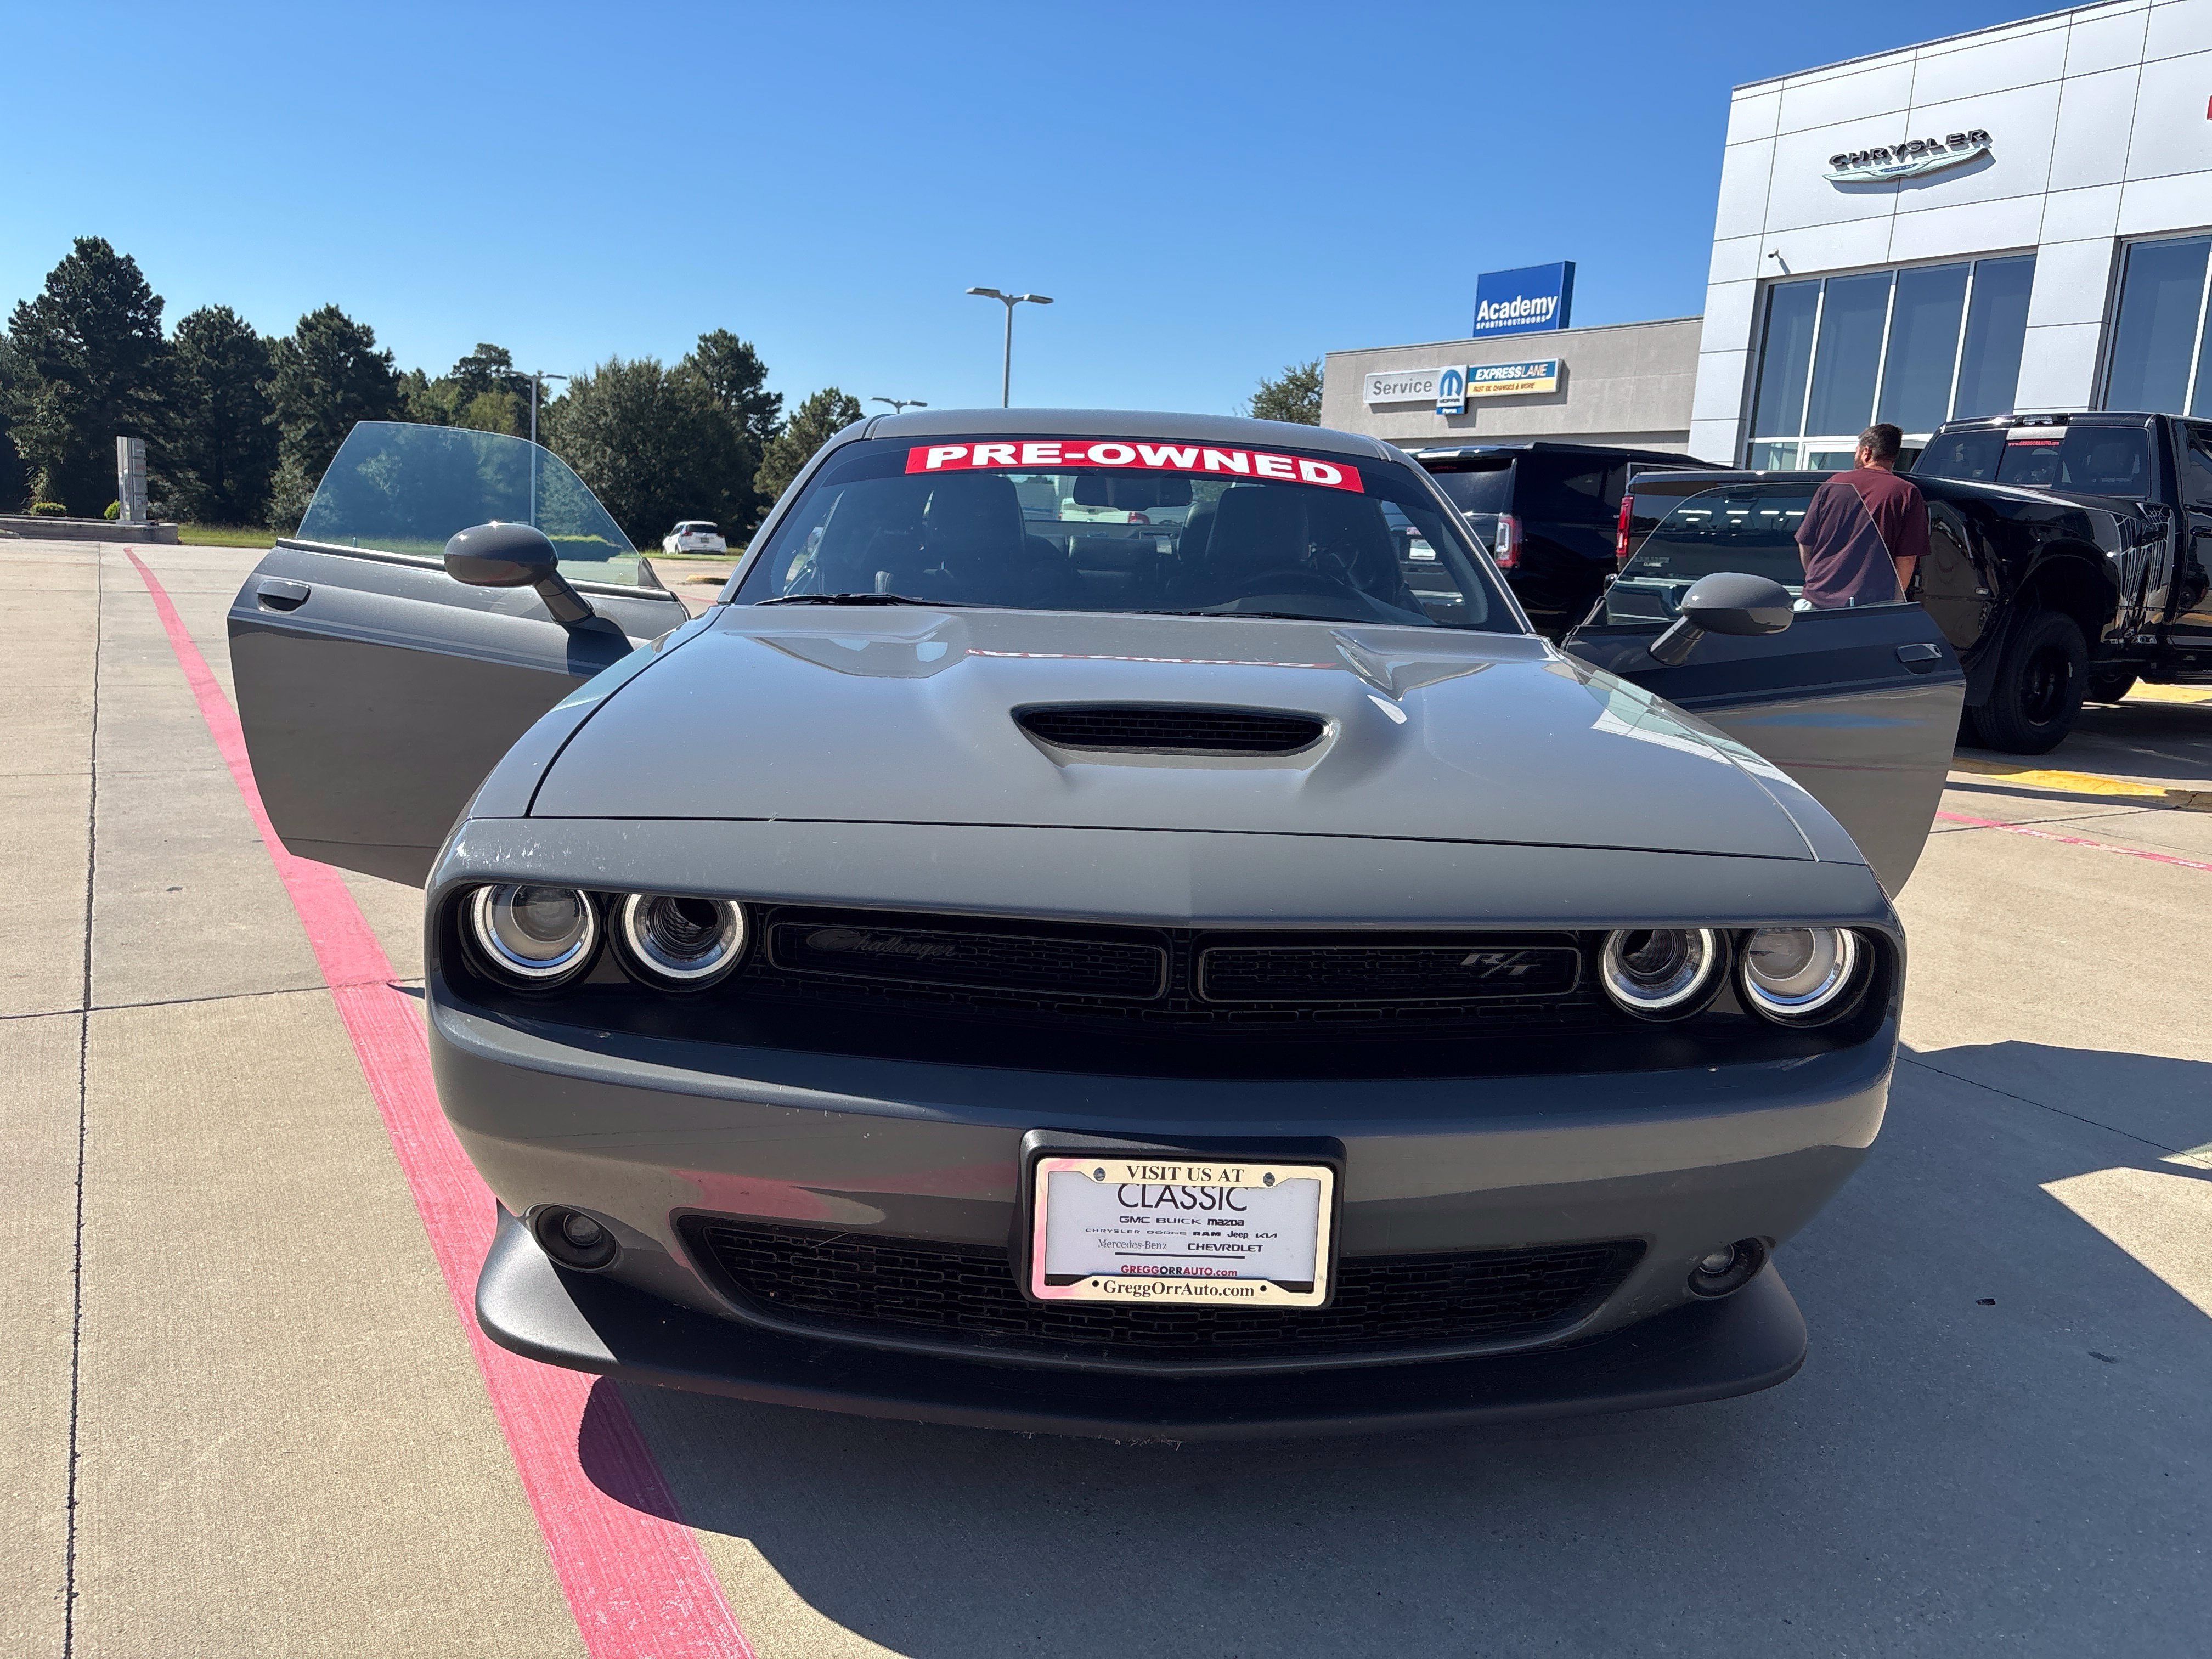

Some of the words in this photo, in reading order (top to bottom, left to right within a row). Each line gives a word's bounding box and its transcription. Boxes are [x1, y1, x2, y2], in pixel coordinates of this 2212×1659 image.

[1829, 129, 1993, 166] CHRYSLER
[1476, 295, 1558, 319] Academy
[1373, 377, 1433, 396] Service
[925, 443, 1343, 485] PRE-OWNED
[1460, 951, 1542, 978] R/T
[1126, 1165, 1181, 1180] VISIT
[1187, 1167, 1212, 1182] US
[1217, 1168, 1245, 1182] AT
[1118, 1183, 1248, 1212] CLASSIC
[1119, 1216, 1150, 1224] GMC
[1207, 1218, 1245, 1227] mazda
[1227, 1230, 1249, 1239] Jeep
[1098, 1239, 1167, 1251] Mercedes-Benz
[1188, 1243, 1263, 1253] CHEVROLET
[1121, 1265, 1238, 1277] GREGGORRAUTO.com
[1103, 1280, 1254, 1297] GreggOrrAuto.com
